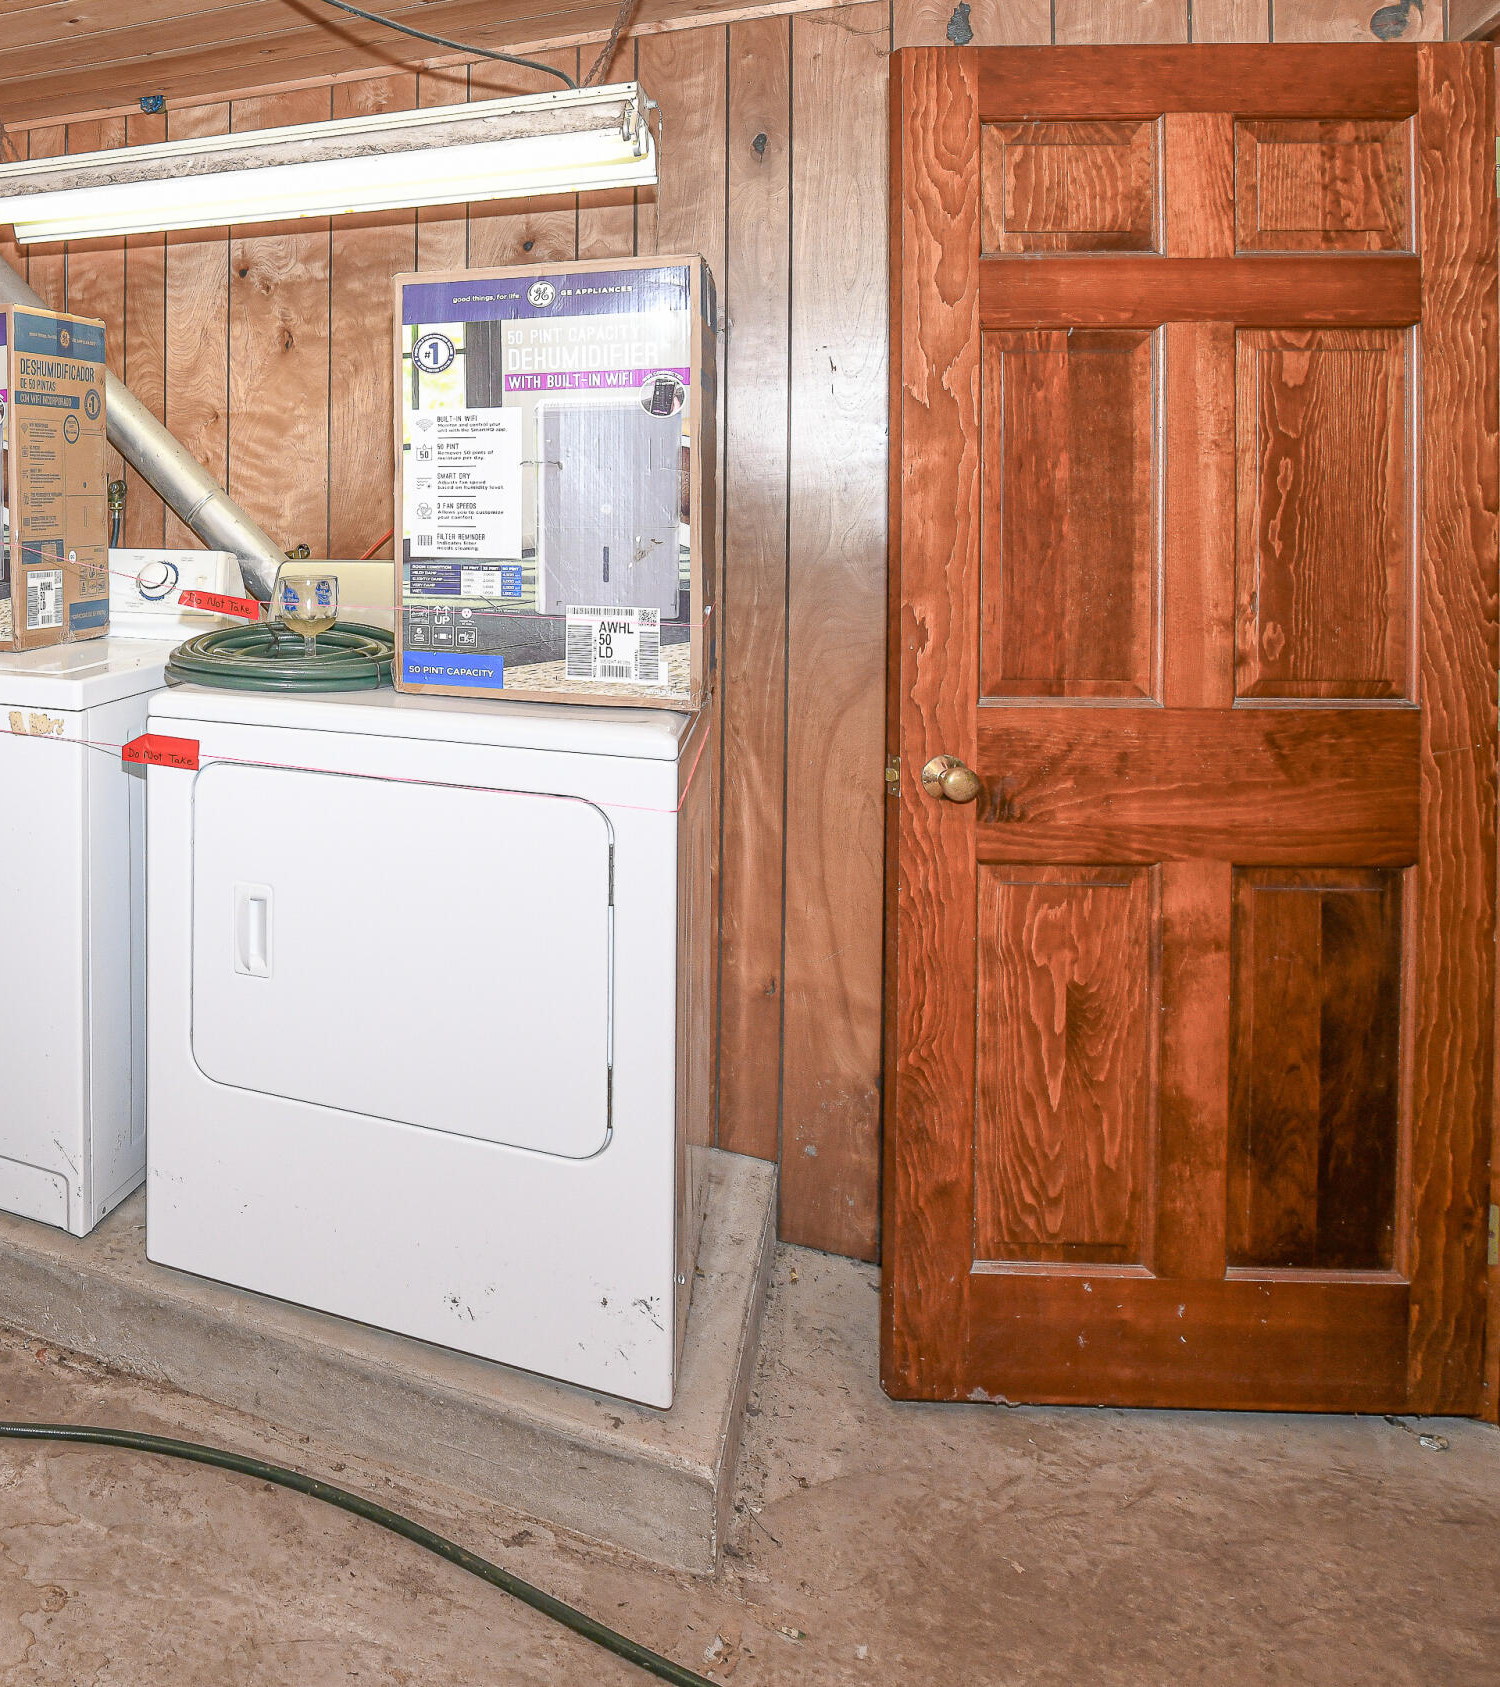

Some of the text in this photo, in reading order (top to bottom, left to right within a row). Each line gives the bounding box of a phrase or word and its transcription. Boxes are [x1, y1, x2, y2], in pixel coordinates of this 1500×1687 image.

[560, 285, 633, 296] GE APPLIANCES
[507, 324, 641, 345] 50 PINT CAPACITY
[425, 342, 438, 365] #1
[507, 342, 660, 371] DEHUMIDIFIER
[20, 358, 94, 382] DESHUMIDIFICADOR
[20, 378, 56, 391] DE 50 PINTAS
[508, 371, 633, 389] WITH BUILT-IN WIFI
[189, 593, 252, 614] Do Not Take
[435, 616, 450, 624] UP
[599, 621, 634, 634] AWHL
[598, 634, 611, 645] 50
[599, 647, 613, 658] LD
[447, 668, 494, 677] CAPACITY
[128, 747, 194, 765] Do Not Take
